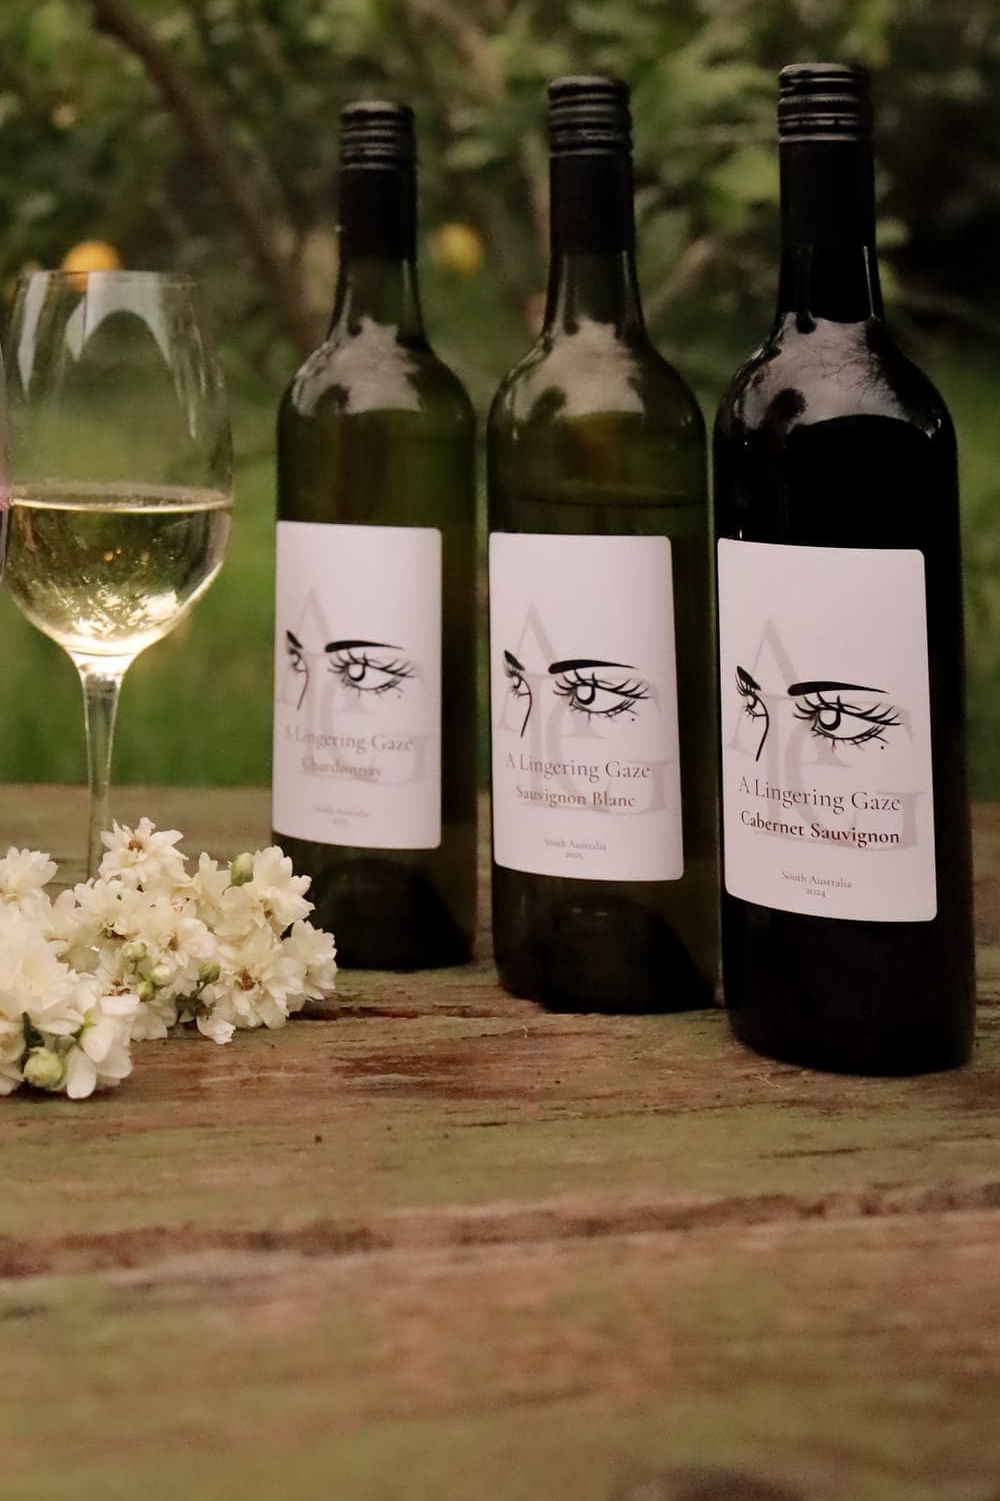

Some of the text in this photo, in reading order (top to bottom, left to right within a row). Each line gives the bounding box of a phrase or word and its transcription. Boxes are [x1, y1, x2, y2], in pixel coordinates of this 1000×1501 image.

[371, 734, 415, 752] Gaze
[505, 752, 651, 783] A Lingering Gaze
[516, 784, 637, 808] Sauvignon Blanc
[738, 775, 902, 815] A Lingering Gaze
[740, 809, 901, 849] Cabernet Sauvignon
[781, 870, 853, 889] South Australia
